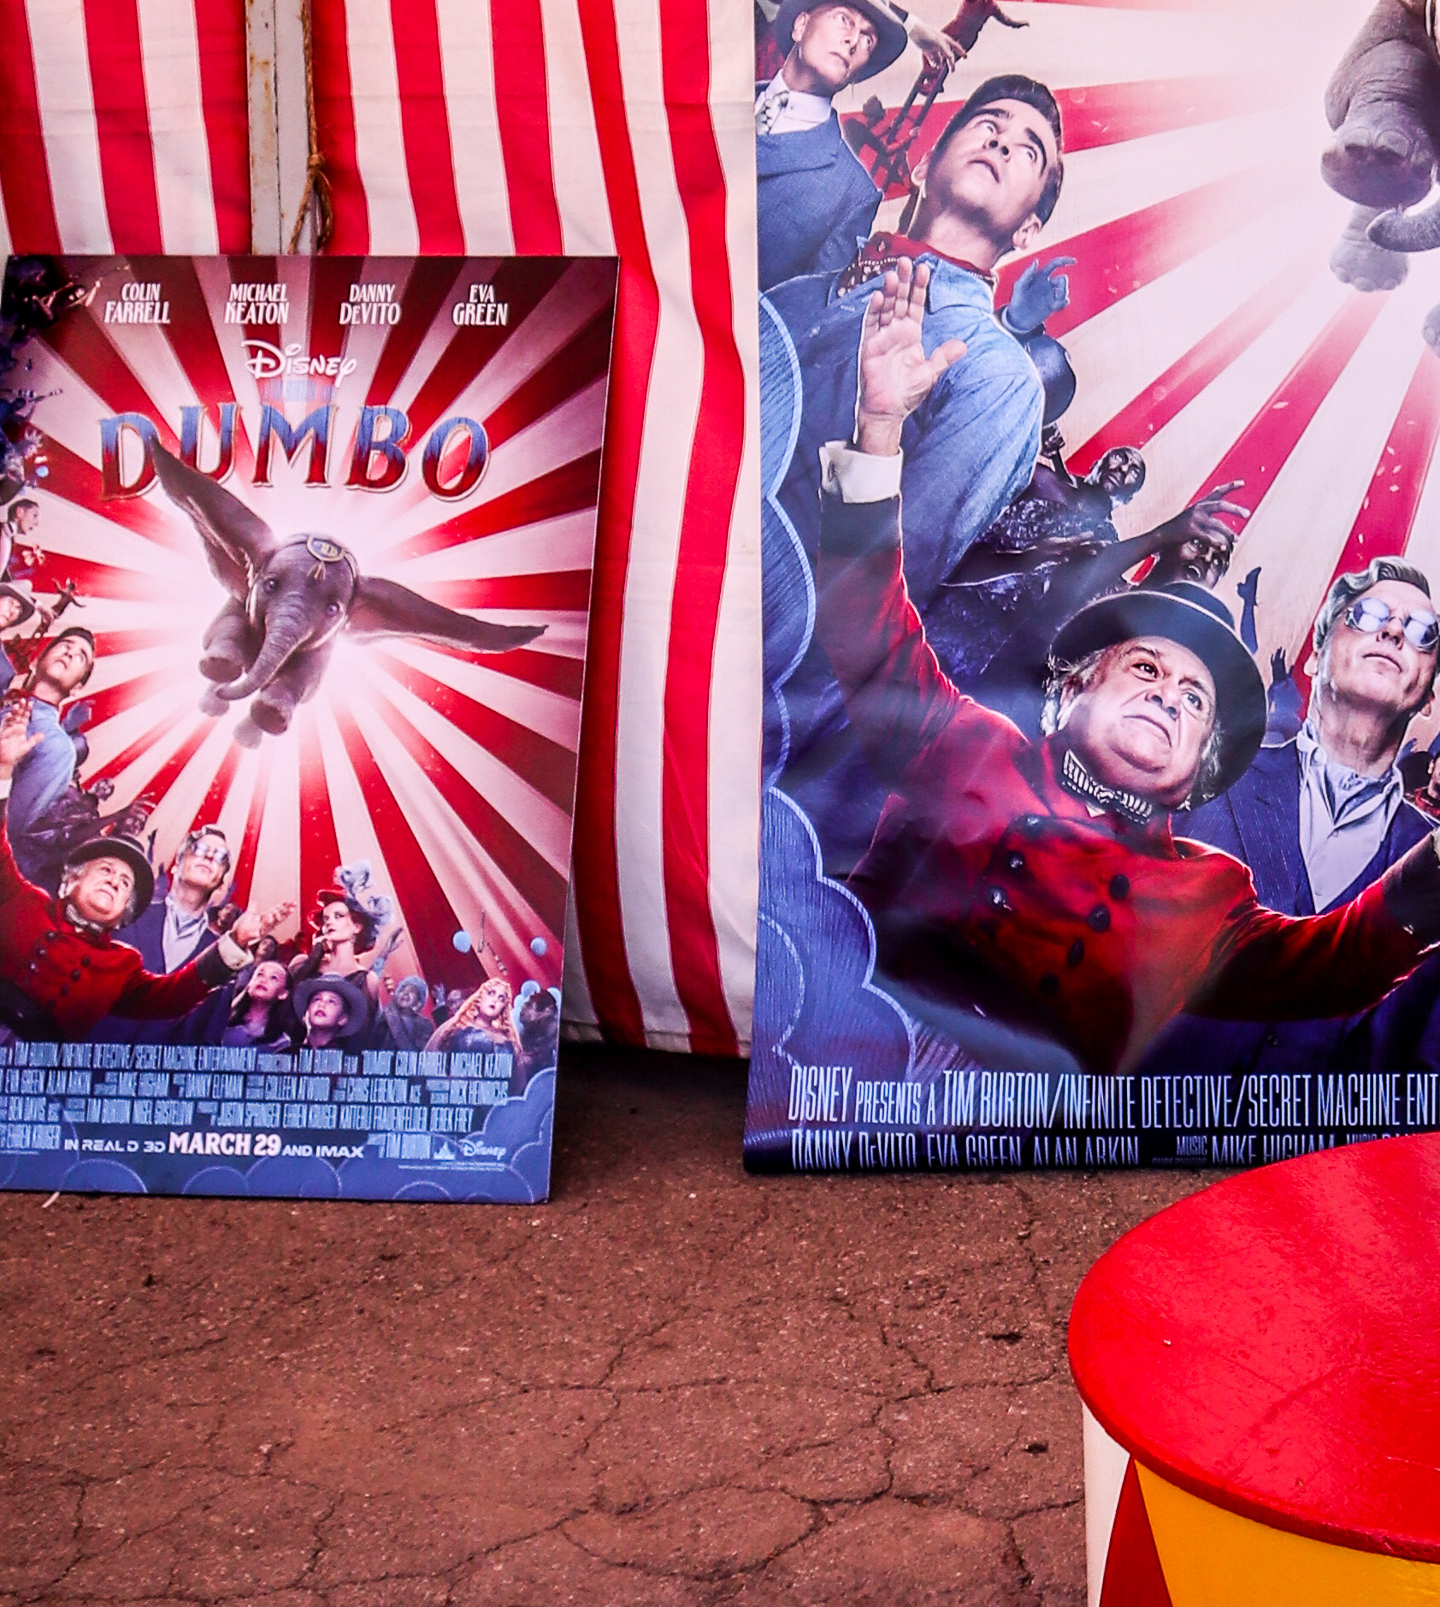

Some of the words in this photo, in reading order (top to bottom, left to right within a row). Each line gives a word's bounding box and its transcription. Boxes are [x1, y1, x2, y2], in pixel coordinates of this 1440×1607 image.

[121, 284, 160, 302] COLIN
[229, 283, 288, 303] MICHAEL
[349, 284, 395, 303] DANNY
[468, 284, 494, 303] EVA
[104, 301, 170, 324] FARRELL
[224, 302, 288, 324] KEATON
[452, 303, 508, 326] GREEN
[241, 339, 357, 389] Disney
[98, 403, 491, 502] DUMBO
[788, 1066, 853, 1122] DISNEY
[855, 1081, 921, 1125] PRESENTS
[926, 1083, 936, 1126] A
[943, 1070, 976, 1127] TIM
[1317, 1073, 1400, 1128] MACHINE
[64, 1139, 79, 1151] IN
[143, 1141, 166, 1153] 3D
[168, 1131, 251, 1156] MARCH
[253, 1133, 282, 1156] 29
[282, 1145, 313, 1157] AND
[316, 1145, 364, 1159] IMAX
